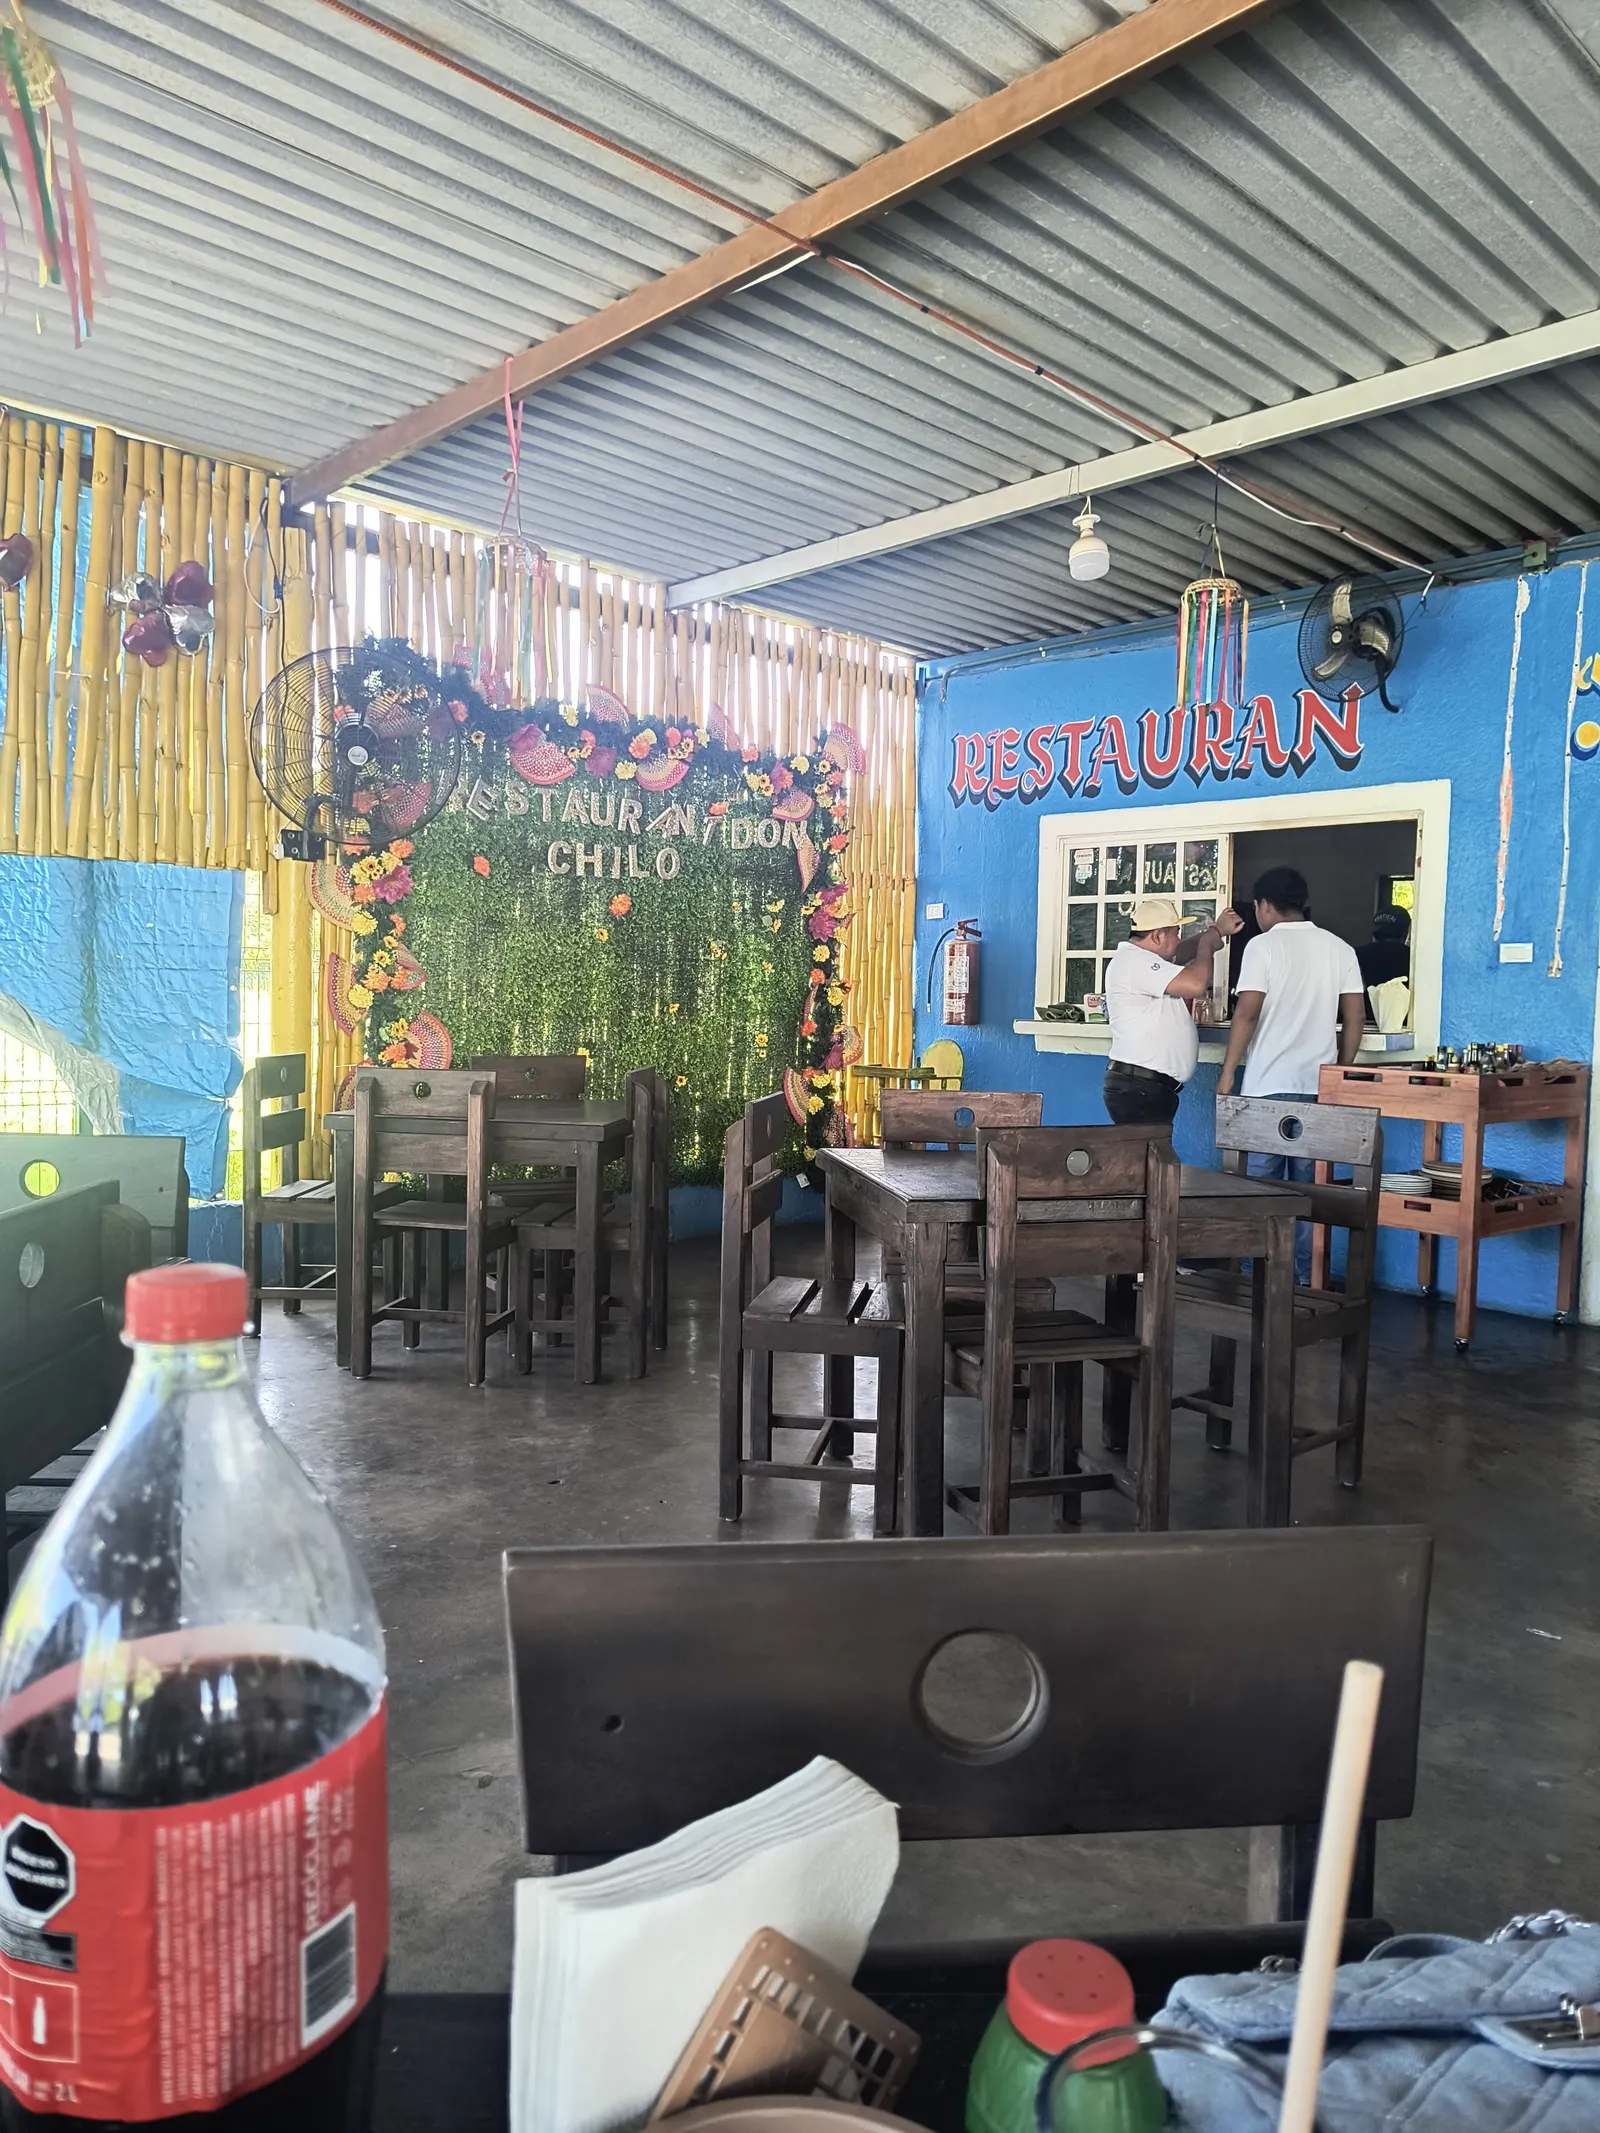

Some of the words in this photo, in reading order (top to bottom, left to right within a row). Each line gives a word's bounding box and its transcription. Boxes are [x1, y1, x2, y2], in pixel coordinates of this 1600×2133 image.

[949, 682, 1366, 809] RESTAURAN
[731, 818, 808, 850] DON
[547, 840, 680, 880] CHILO
